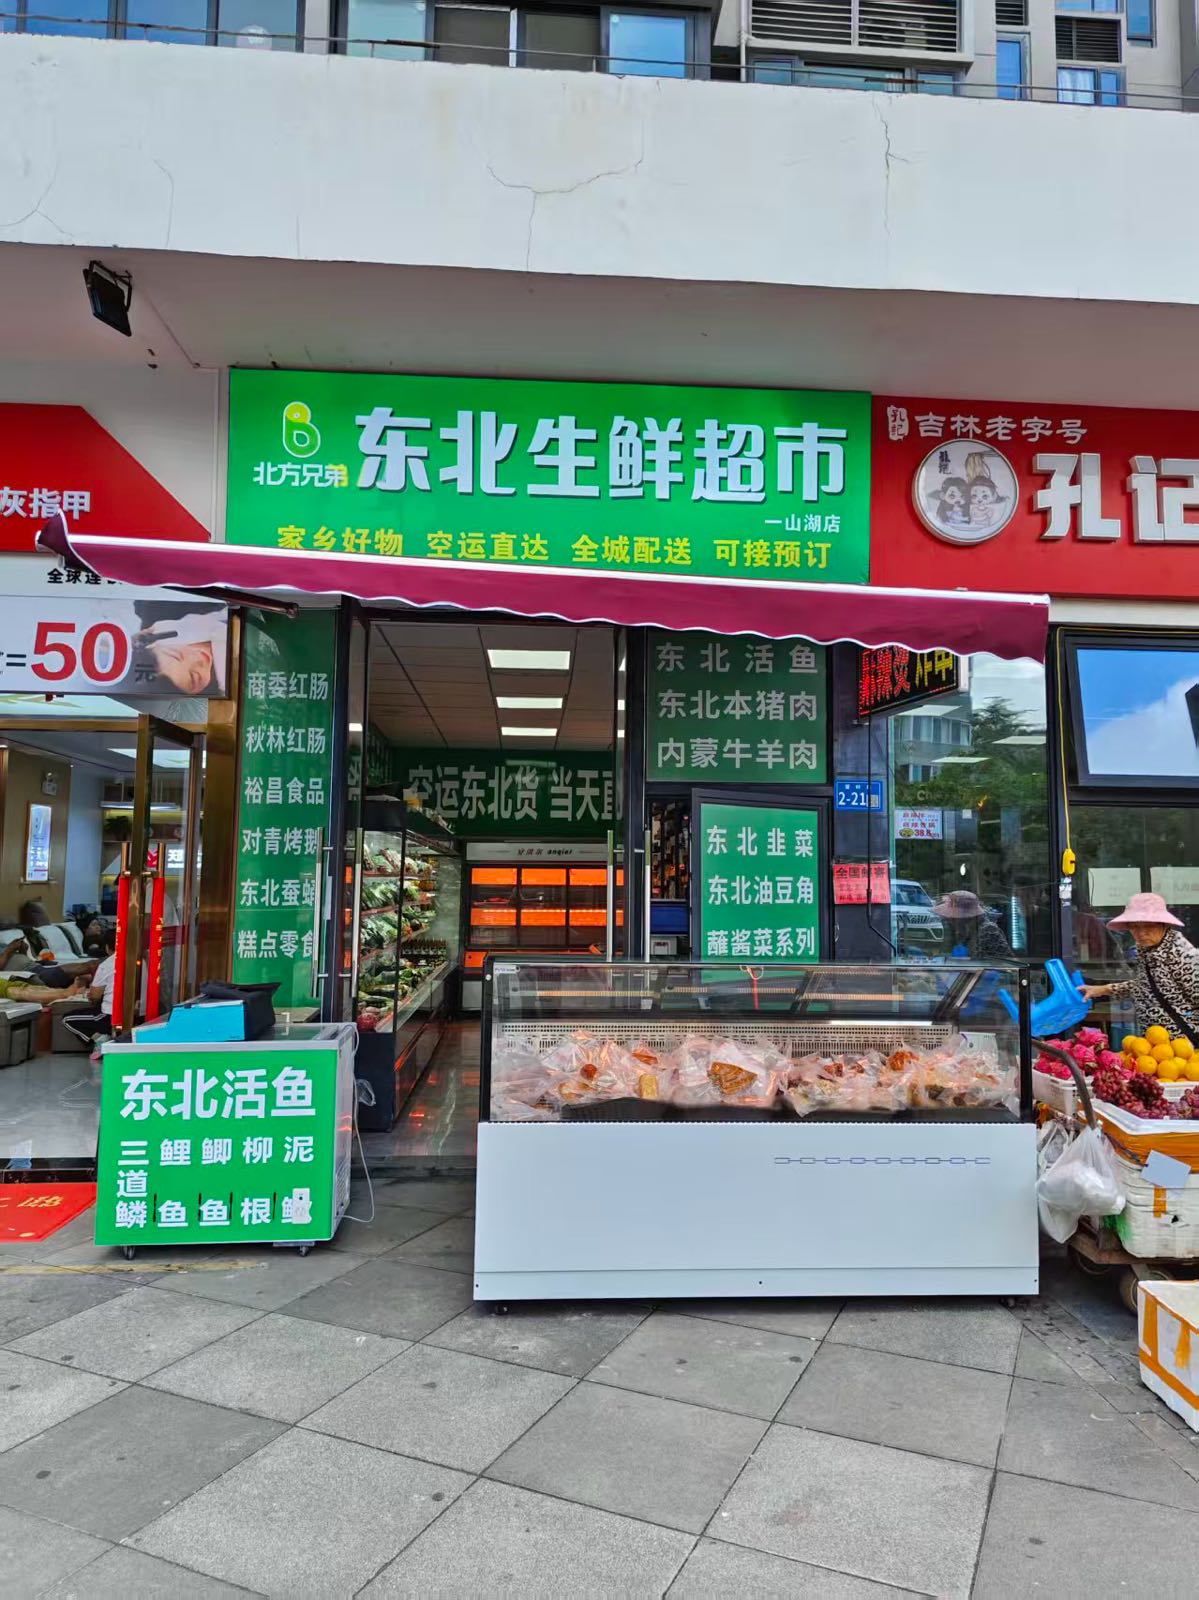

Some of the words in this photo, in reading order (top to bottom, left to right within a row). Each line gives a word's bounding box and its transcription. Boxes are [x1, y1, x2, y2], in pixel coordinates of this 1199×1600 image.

[914, 412, 1088, 444] 吉林老字号
[355, 406, 847, 503] 东北生鲜超市
[253, 461, 348, 488] 北方兄弟
[0, 487, 90, 520] 灰指甲
[1032, 452, 1199, 543] 孔记
[765, 514, 840, 533] 一山湖店
[277, 525, 404, 557] 家乡好物
[427, 531, 549, 562] 空运直达
[572, 533, 692, 566] 全城配送
[714, 538, 832, 569] 可接预订
[656, 643, 818, 675] 东北活鱼
[247, 672, 328, 700] 商委红肠
[658, 690, 818, 721] 东北本猪肉
[245, 726, 326, 754] 秋林红肠
[657, 738, 818, 770] 内蒙牛羊肉
[244, 777, 325, 805] 裕昌食品
[838, 791, 867, 806] 2-21
[706, 825, 813, 858] 东北韭菜
[708, 876, 814, 905] 东北油豆角
[237, 929, 313, 959] 糕点零食
[707, 926, 815, 957] 蘸酱菜系列
[119, 1065, 316, 1121] 东北活鱼
